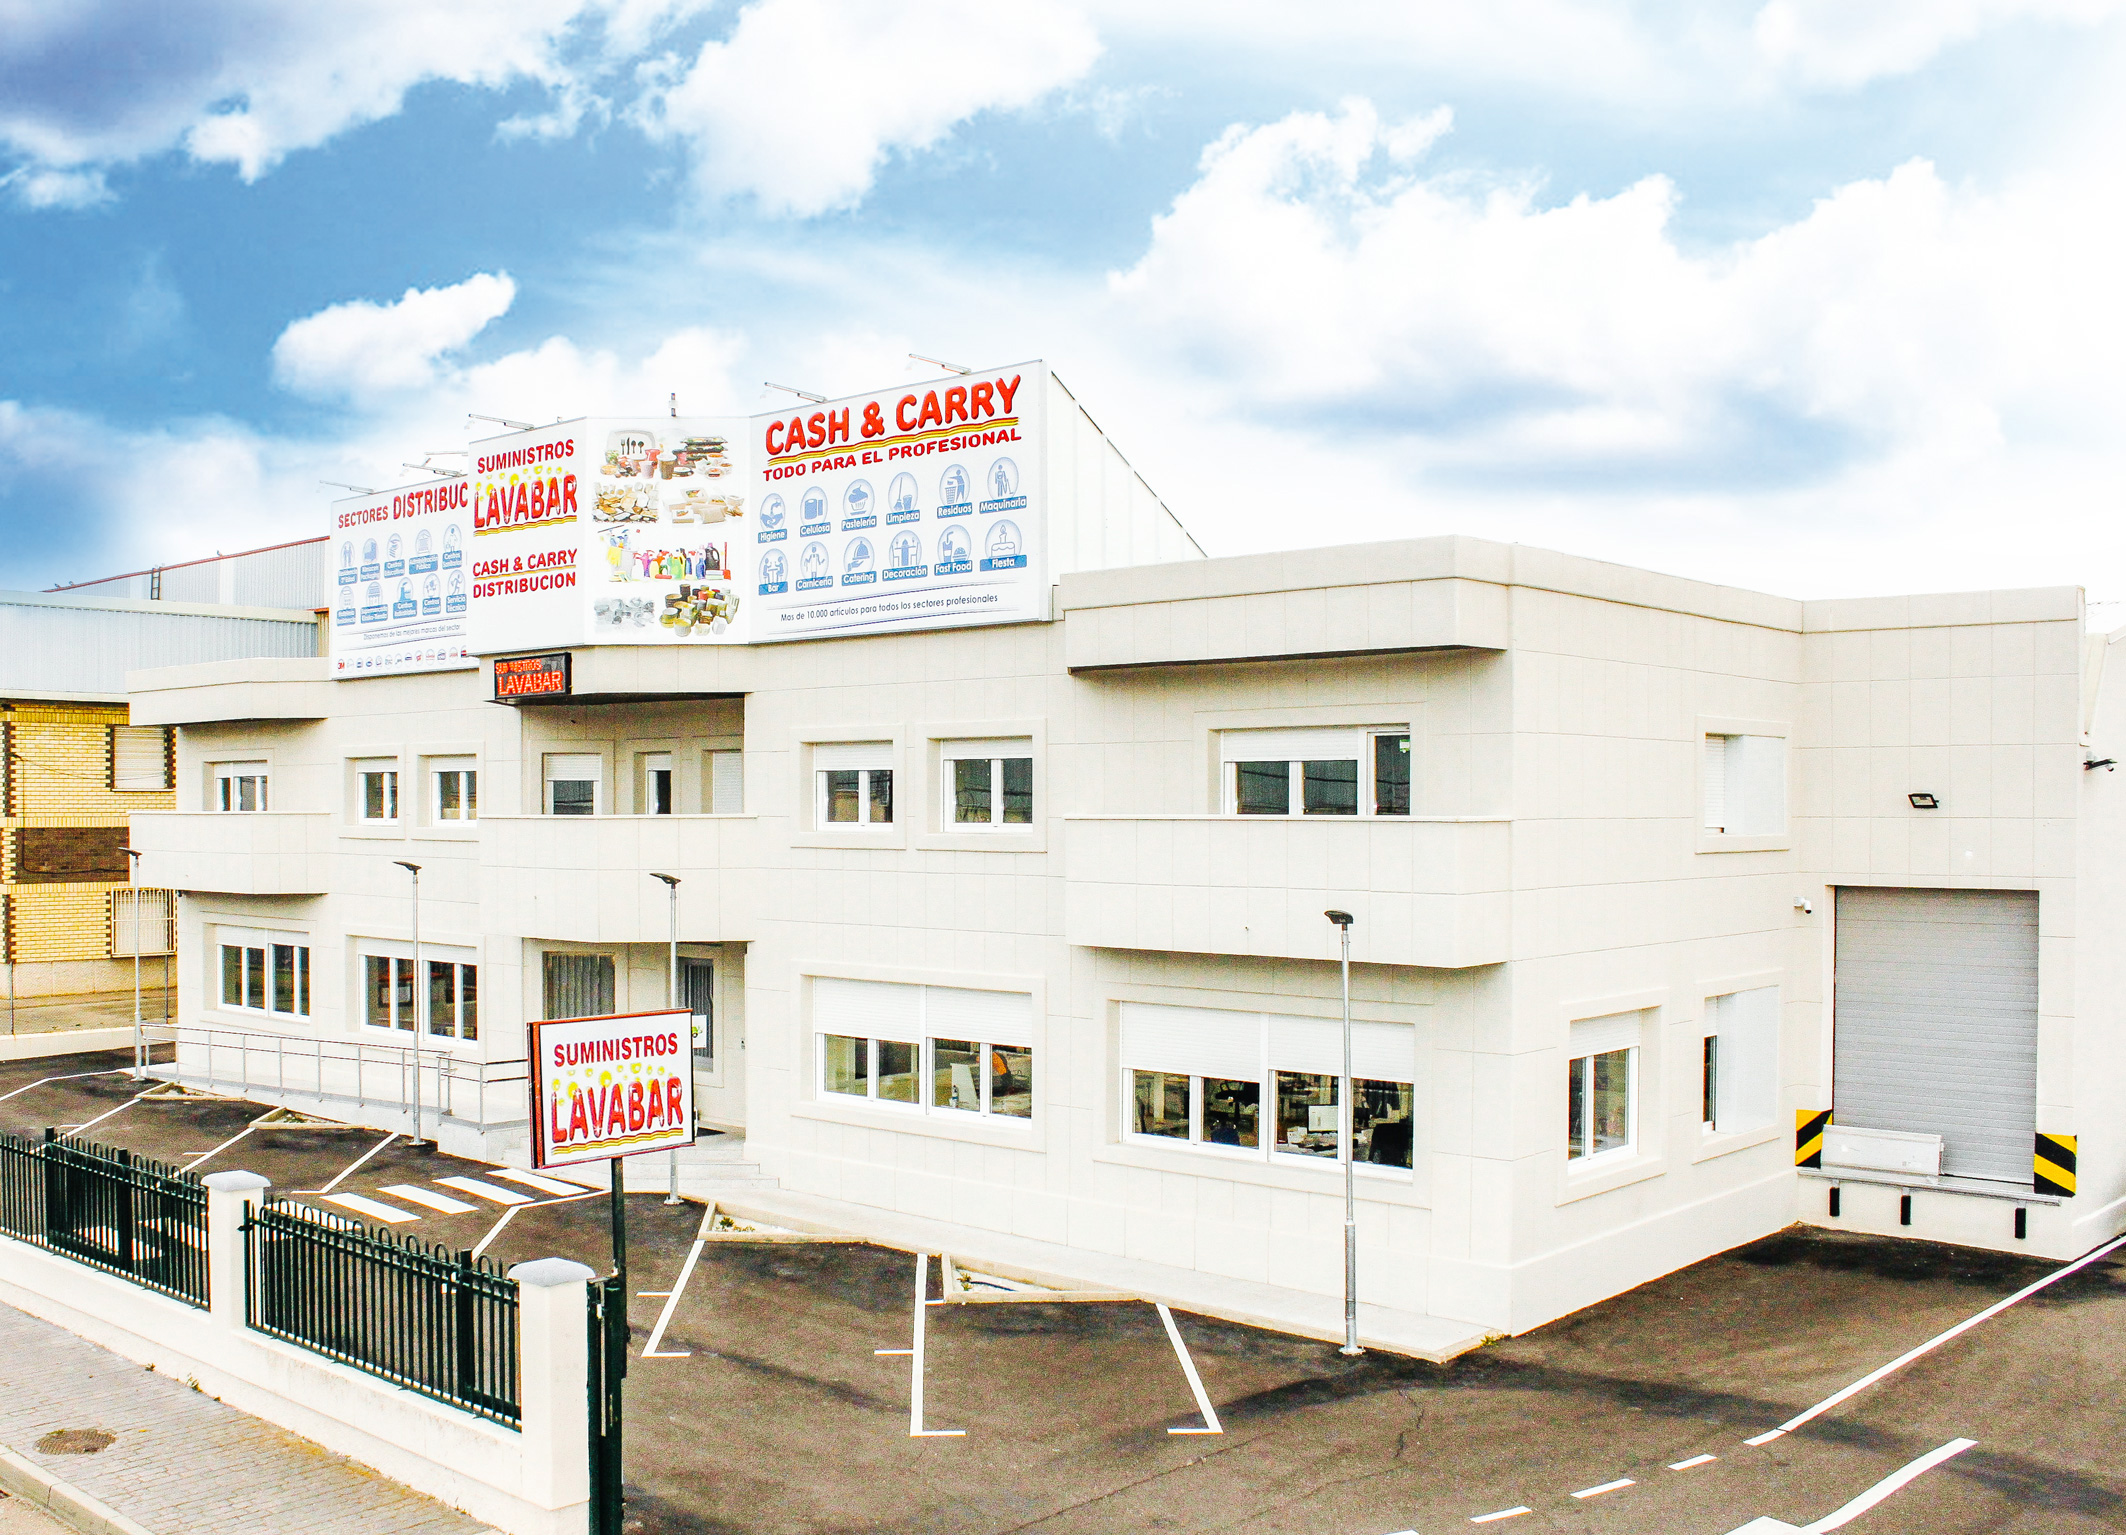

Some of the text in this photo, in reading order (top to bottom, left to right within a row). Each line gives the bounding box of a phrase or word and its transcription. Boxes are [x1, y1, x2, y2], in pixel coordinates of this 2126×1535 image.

[766, 375, 1021, 455] CASH & CARRY
[478, 439, 574, 474] SUMINISTROS
[763, 428, 1021, 481] TODO PARA EL PROFESIONAL
[339, 482, 468, 528] SECTORES DISTRIBUC
[474, 474, 577, 528] LAVABAR
[938, 504, 972, 516] Residuos
[980, 498, 1026, 512] Maquinaria
[887, 512, 920, 524] Limpieza
[760, 532, 785, 542] Higiene
[801, 524, 830, 535] Celulosa
[473, 558, 508, 576] CASH
[513, 556, 522, 571] &
[528, 548, 577, 569] CARRY
[936, 560, 972, 573] Fast Food
[992, 558, 1015, 568] Fiesta
[844, 573, 874, 584] Catering
[884, 566, 927, 579] Decoración
[473, 572, 576, 598] DISTRIBUCION
[768, 584, 779, 592] Bar
[797, 612, 805, 620] de
[807, 609, 828, 619] 10.000
[860, 606, 877, 615] para
[879, 603, 898, 612] todos
[901, 601, 911, 610] los
[913, 599, 944, 608] sectores
[946, 594, 998, 607] profesionales
[403, 629, 420, 638] mejores
[497, 670, 563, 695] LAVABAR
[554, 1033, 678, 1067] SUMINISTROS
[552, 1076, 683, 1143] LAVABAR
